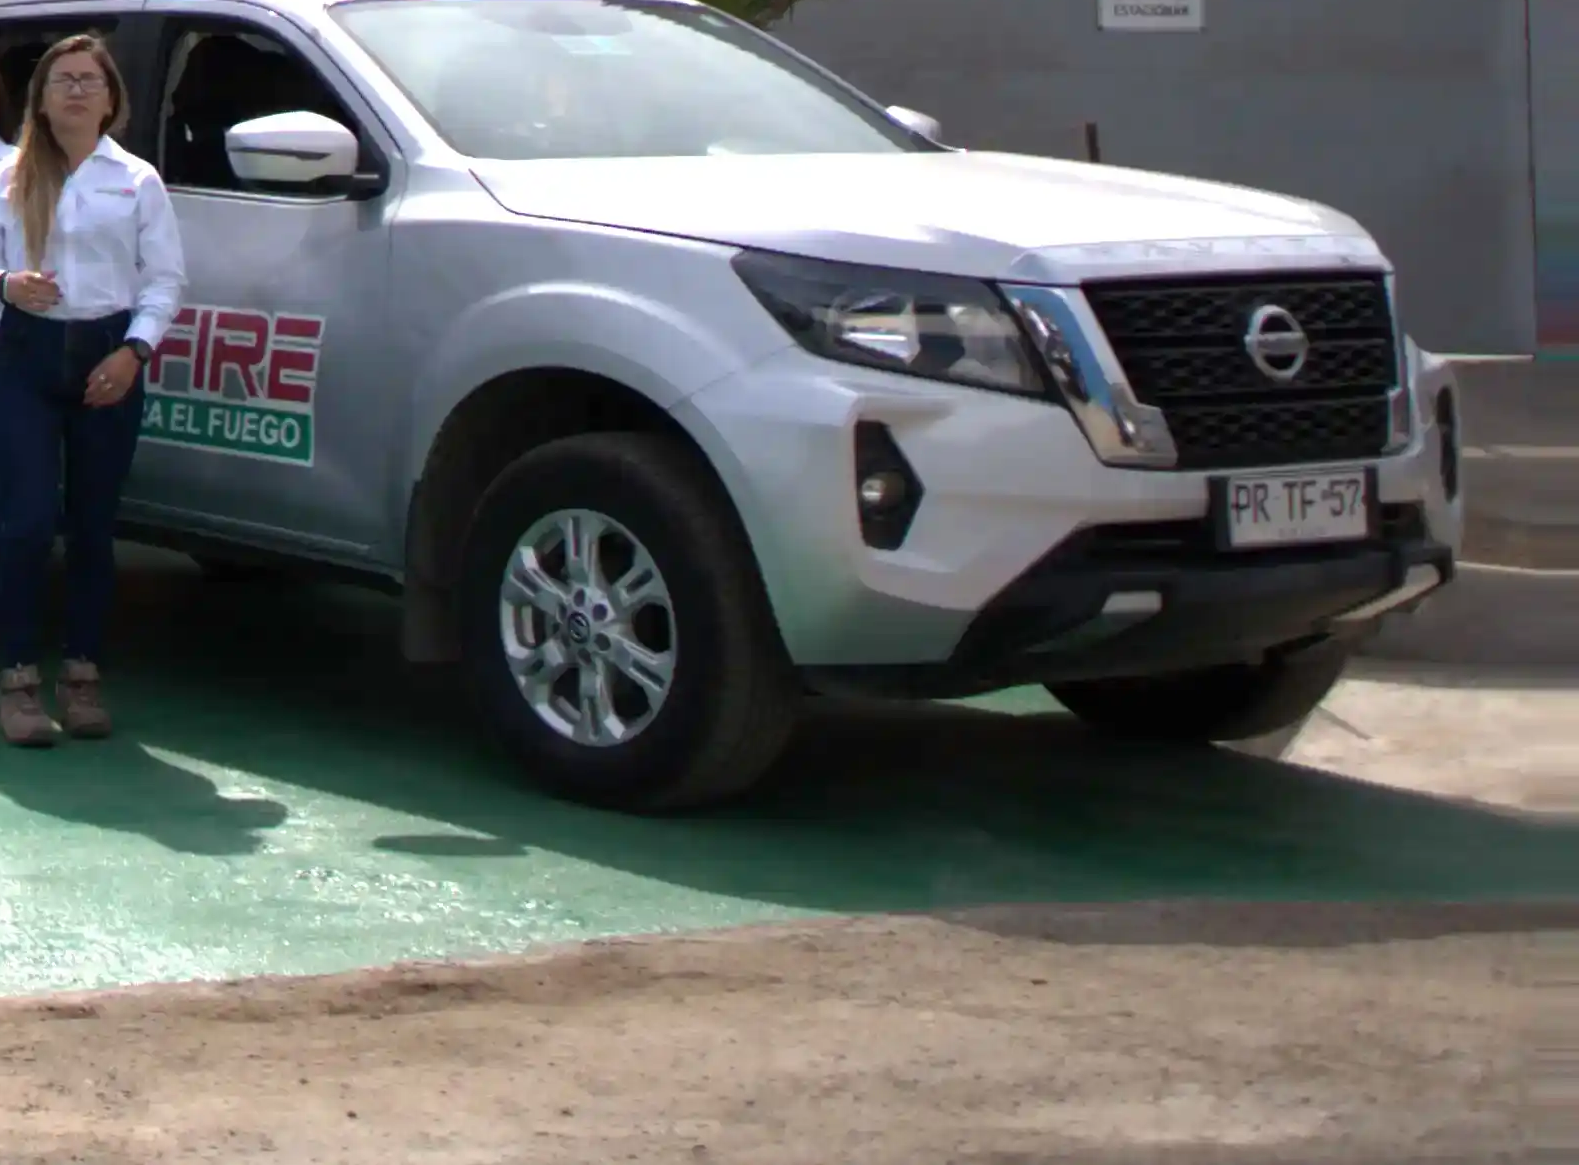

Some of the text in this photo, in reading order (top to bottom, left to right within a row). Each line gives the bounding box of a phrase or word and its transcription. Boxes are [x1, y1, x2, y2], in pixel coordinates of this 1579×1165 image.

[170, 402, 201, 436] EL
[208, 407, 302, 448] FUEGO
[1236, 483, 1271, 525] PR
[1282, 480, 1317, 522] TF
